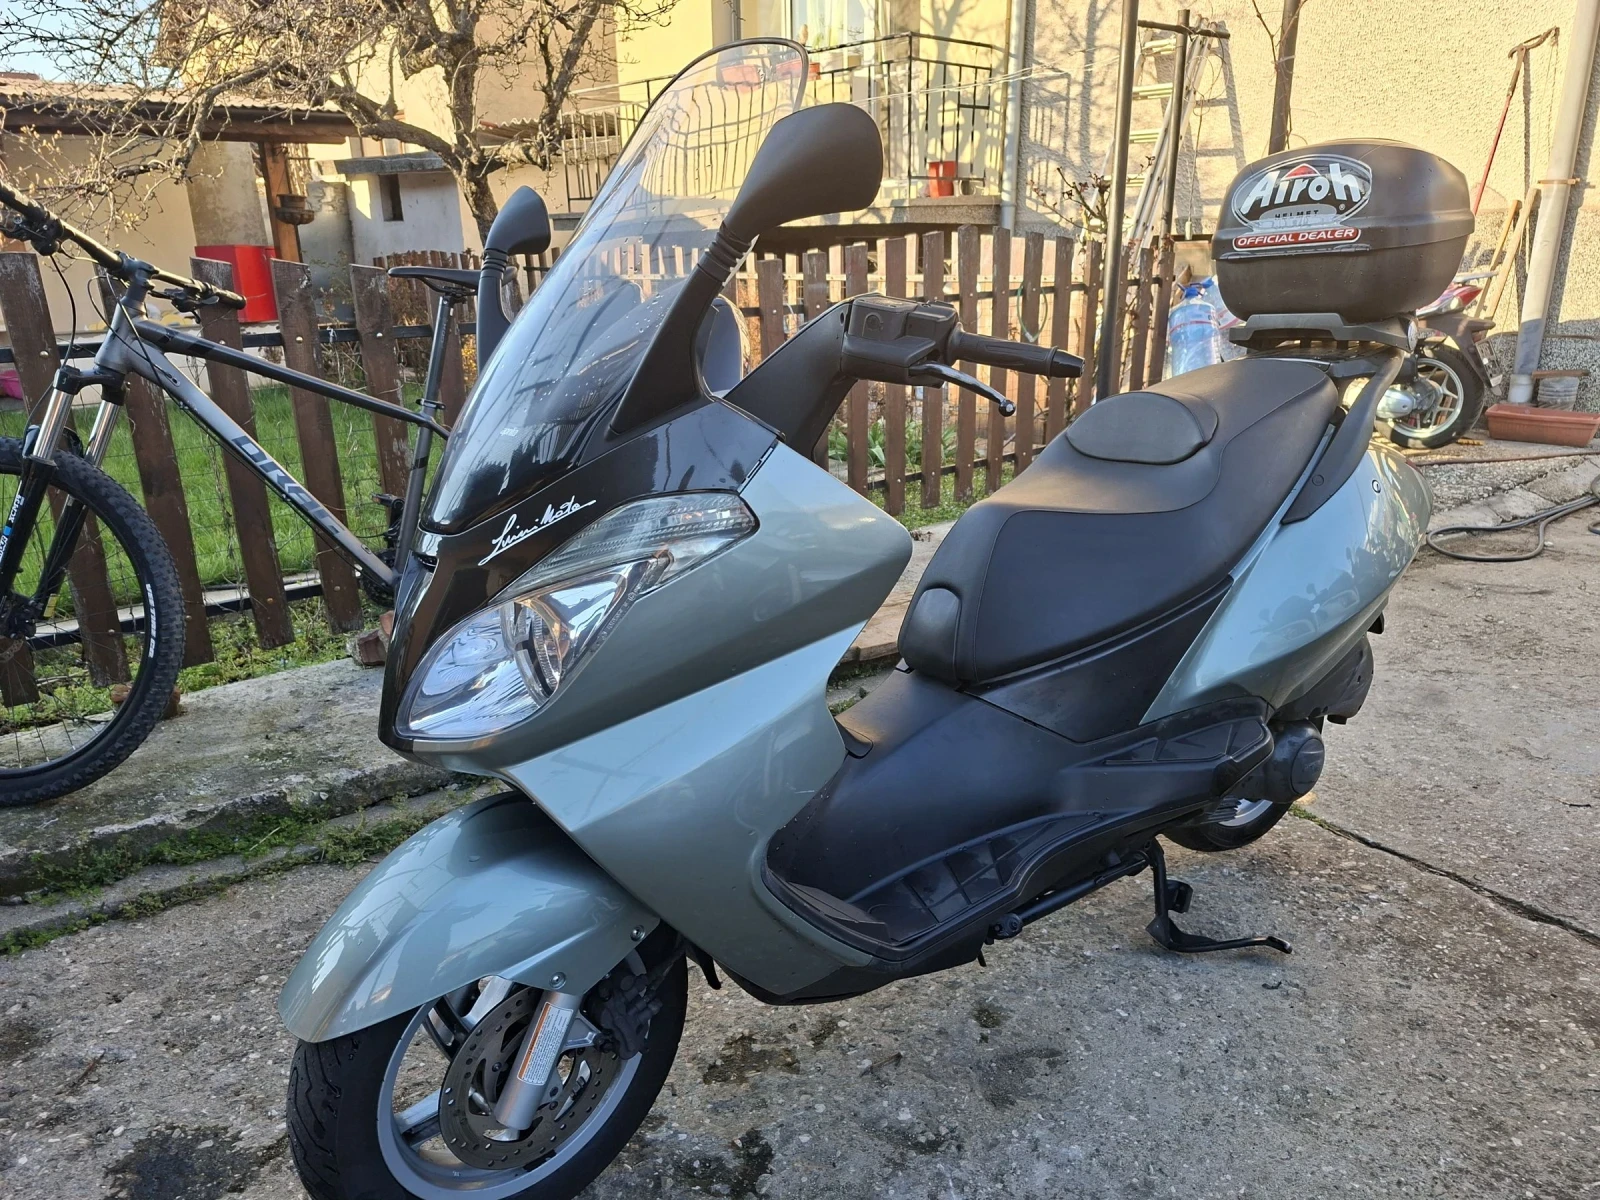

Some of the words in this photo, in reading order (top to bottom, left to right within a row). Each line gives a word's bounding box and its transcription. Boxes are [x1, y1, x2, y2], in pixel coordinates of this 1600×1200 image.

[1240, 163, 1362, 215] Airoh
[1237, 233, 1295, 246] OFFICIAL
[1298, 228, 1355, 241] DEALER
[232, 436, 345, 536] DRAG
